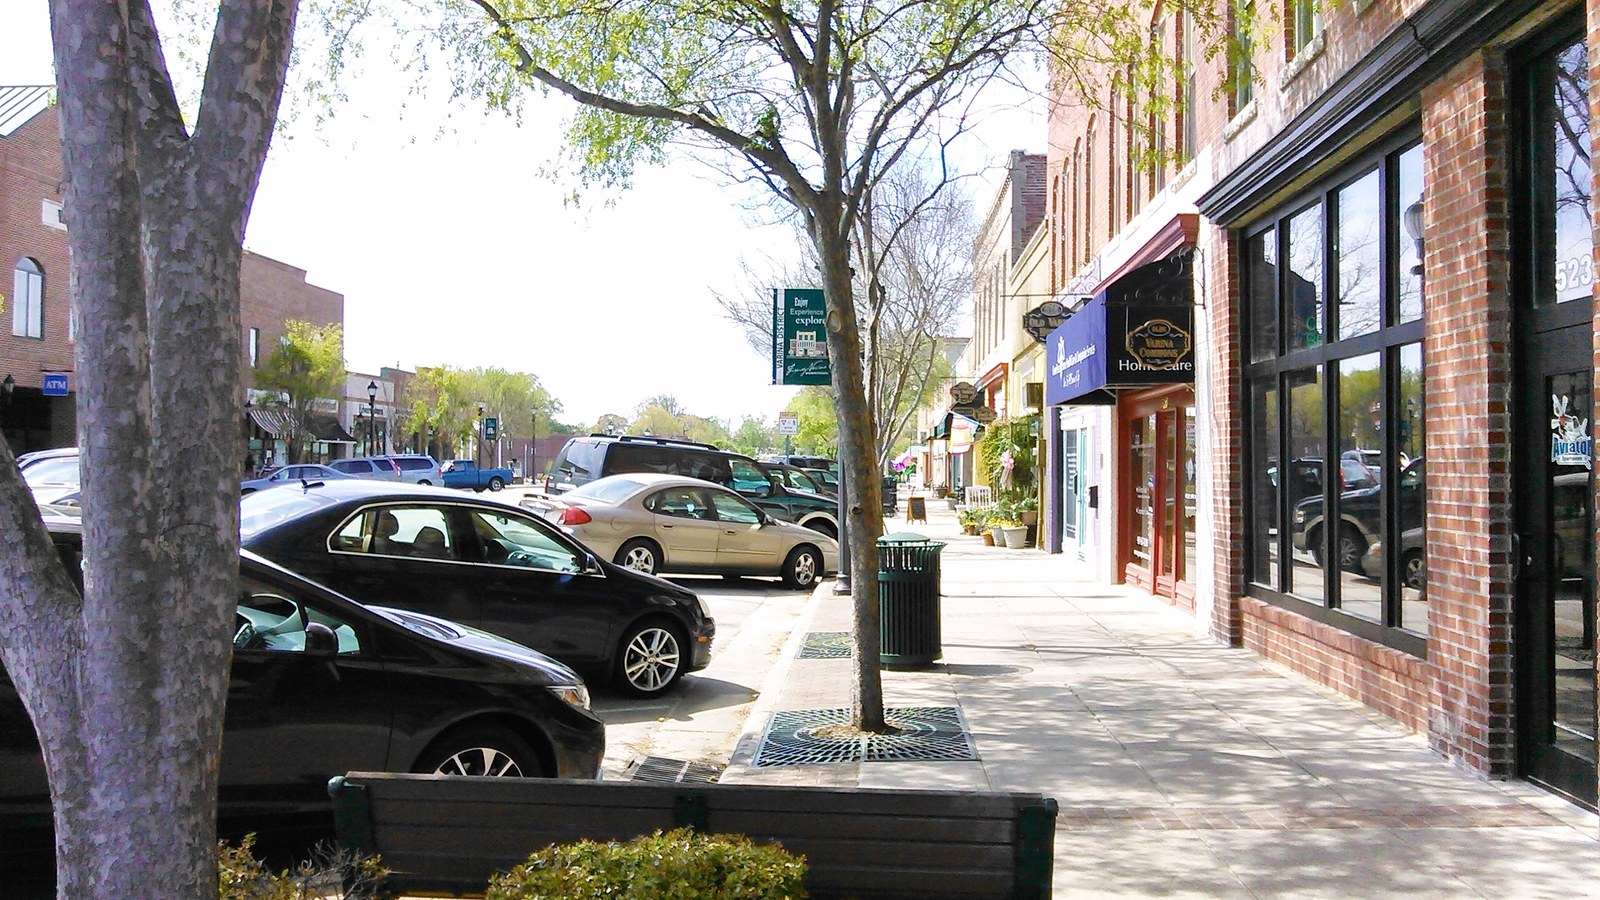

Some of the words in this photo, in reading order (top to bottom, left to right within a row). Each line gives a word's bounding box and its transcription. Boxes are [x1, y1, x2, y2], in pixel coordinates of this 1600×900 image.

[1555, 254, 1592, 293] 523
[794, 297, 808, 308] Enjoy
[790, 308, 824, 316] Experience
[1119, 360, 1151, 371] Hom
[46, 381, 66, 389] ATM
